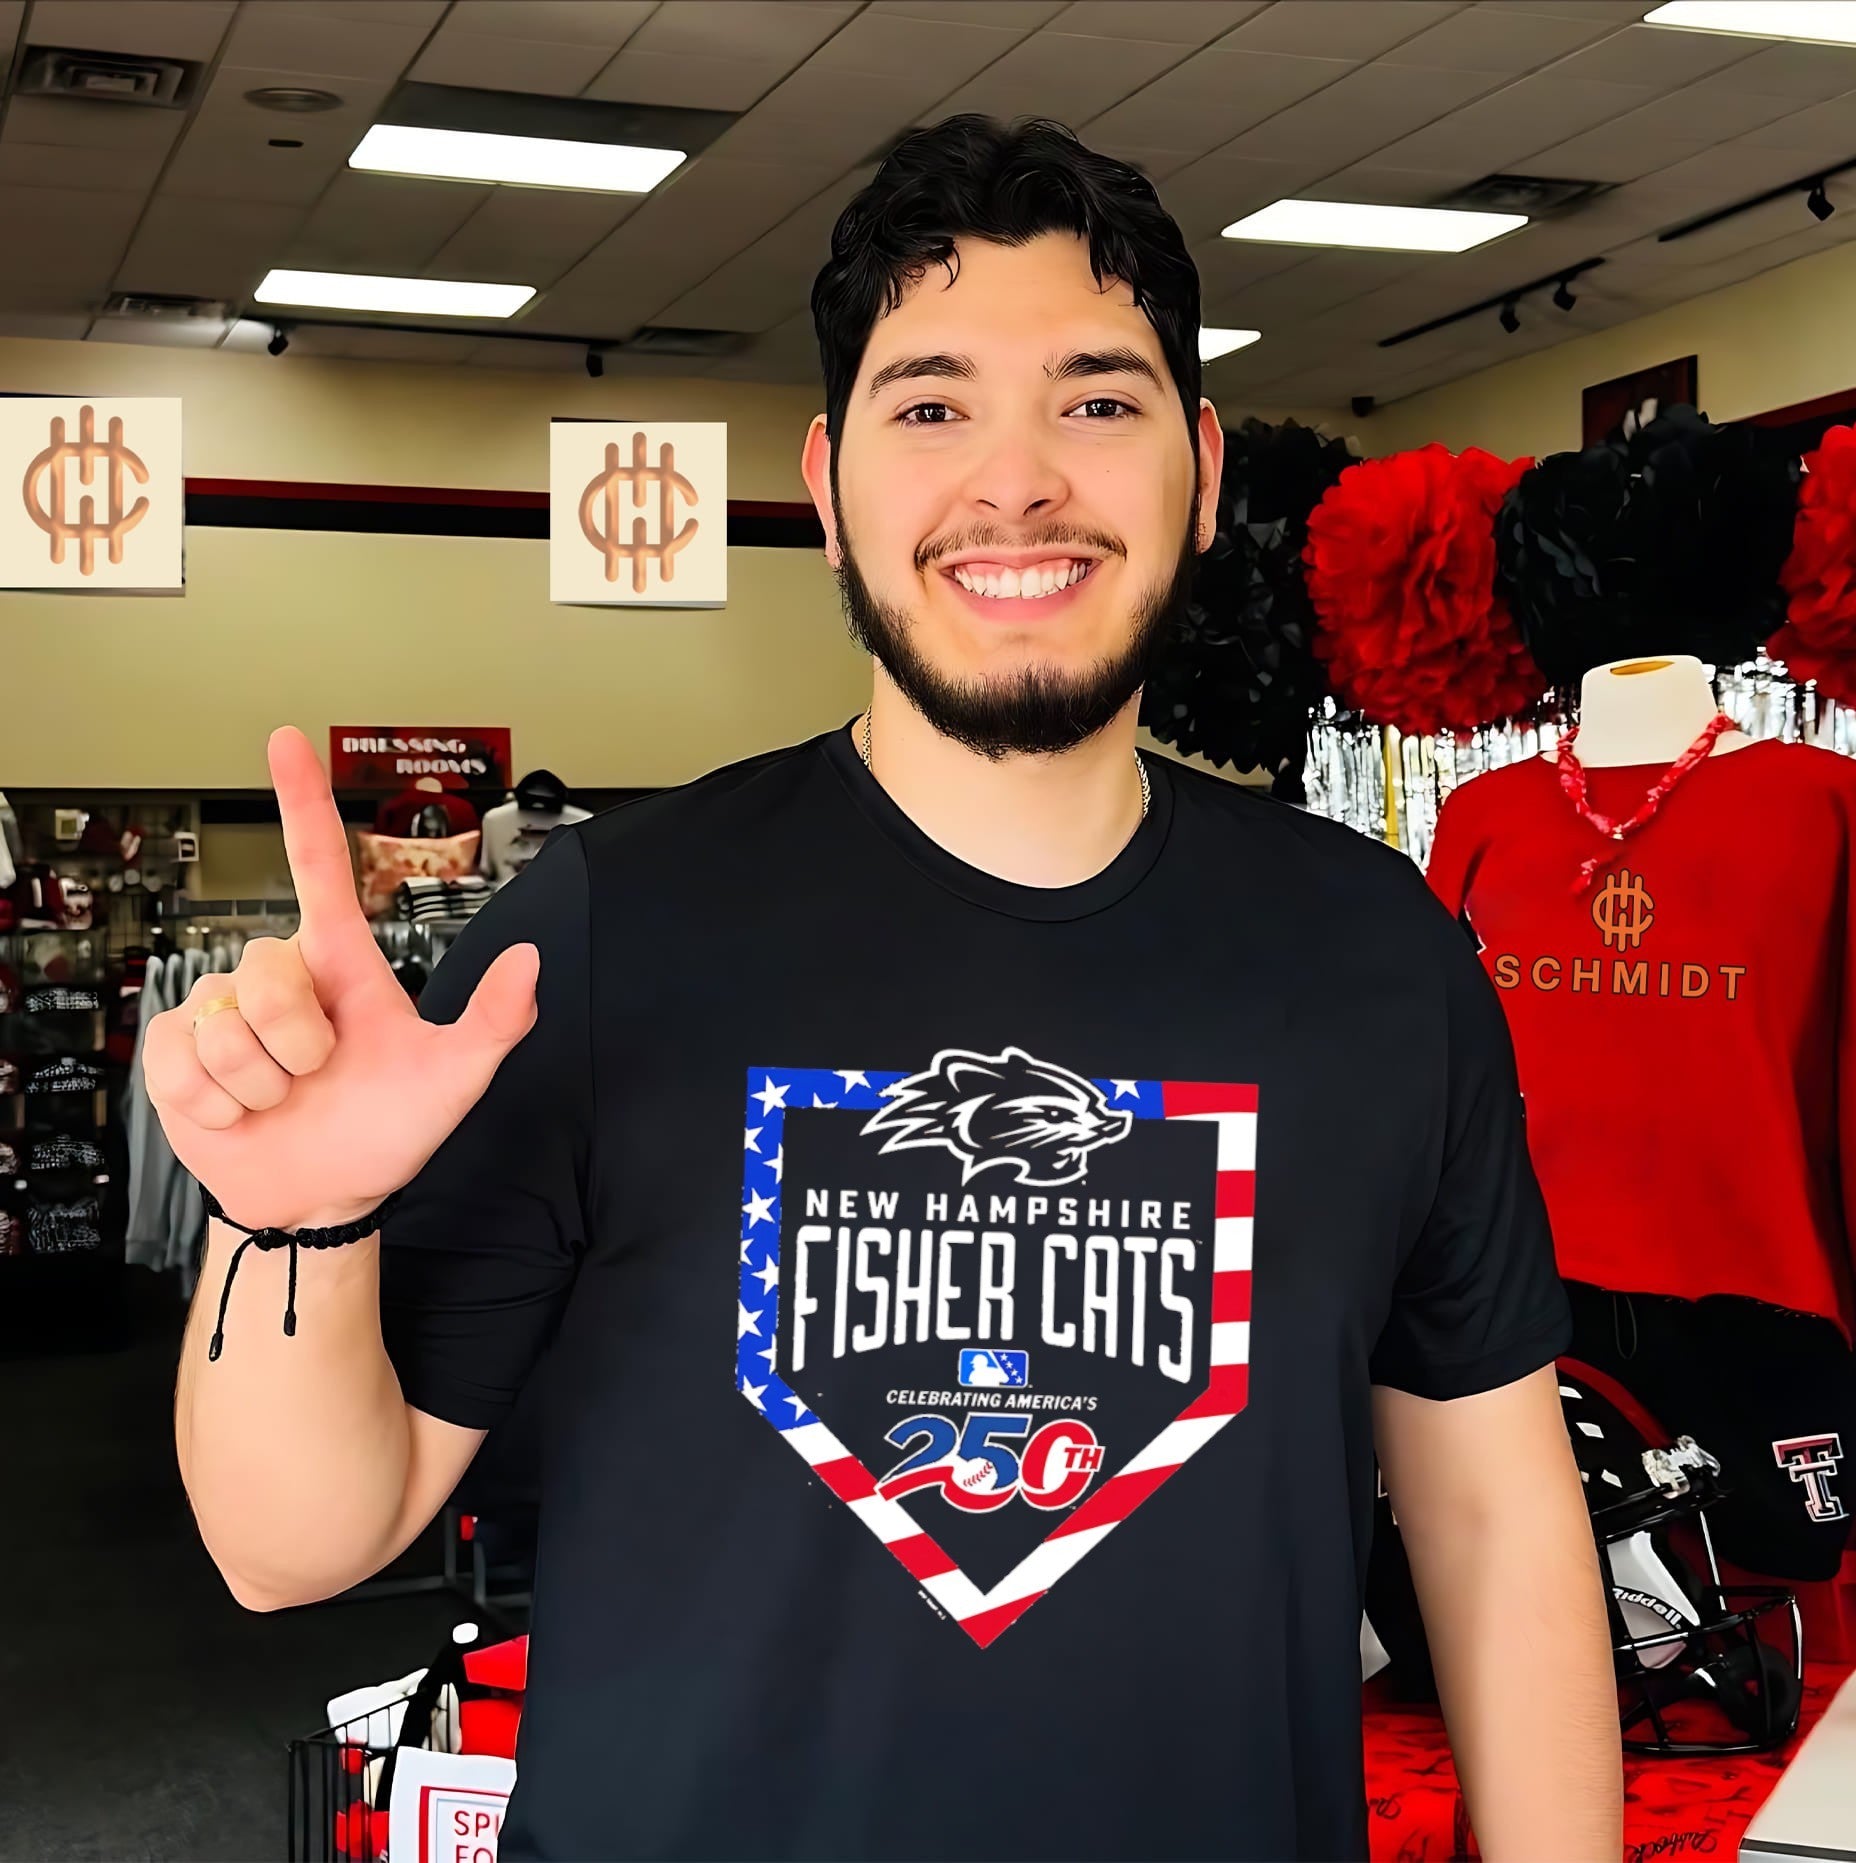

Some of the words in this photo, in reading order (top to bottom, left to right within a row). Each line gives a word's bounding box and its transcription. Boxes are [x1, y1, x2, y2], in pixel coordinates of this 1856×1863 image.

[1494, 953, 1747, 1000] SCHMIDT
[805, 1188, 900, 1220] NEW
[925, 1193, 1192, 1231] HAMPSHIRE
[792, 1225, 1017, 1374] FISHER
[1040, 1233, 1196, 1385] CATS
[886, 1389, 1001, 1408] CELEBRATING
[1004, 1395, 1099, 1412] AMERICA'S
